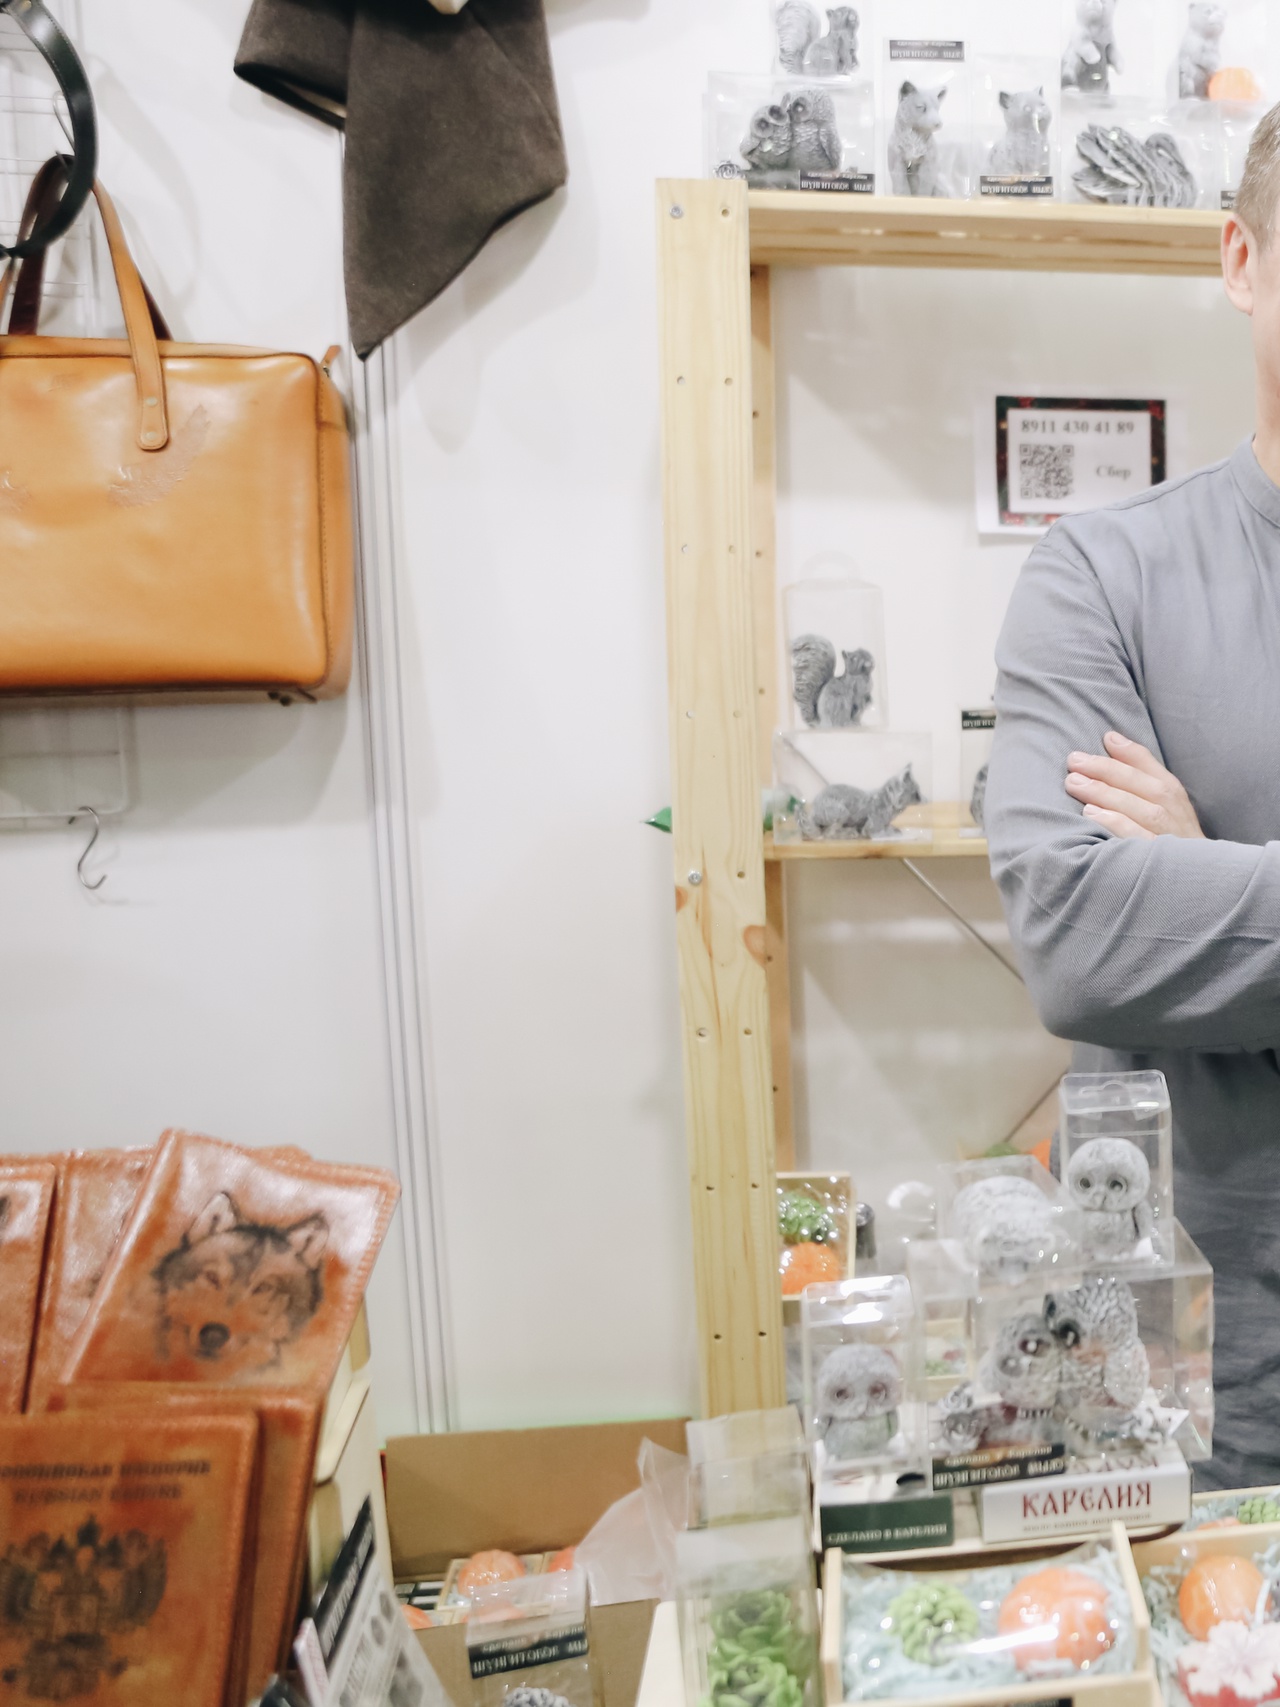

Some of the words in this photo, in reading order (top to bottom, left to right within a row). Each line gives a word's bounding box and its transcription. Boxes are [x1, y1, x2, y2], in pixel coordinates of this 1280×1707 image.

[1021, 419, 1056, 434] 8911
[1063, 420, 1090, 434] 430
[1095, 420, 1110, 435] 41
[1117, 420, 1135, 435] 89
[1096, 465, 1132, 482] Сбер
[933, 1463, 1020, 1488] ШУНГИТОВОЕ
[1027, 1457, 1064, 1476] МЫЛО
[1022, 1480, 1152, 1519] КАРЕЛИЯ
[828, 1529, 882, 1544] СДЕЛАНО
[892, 1523, 947, 1539] КАРЕЛИИ
[473, 1645, 560, 1674] ШУНГИТОВОЕ
